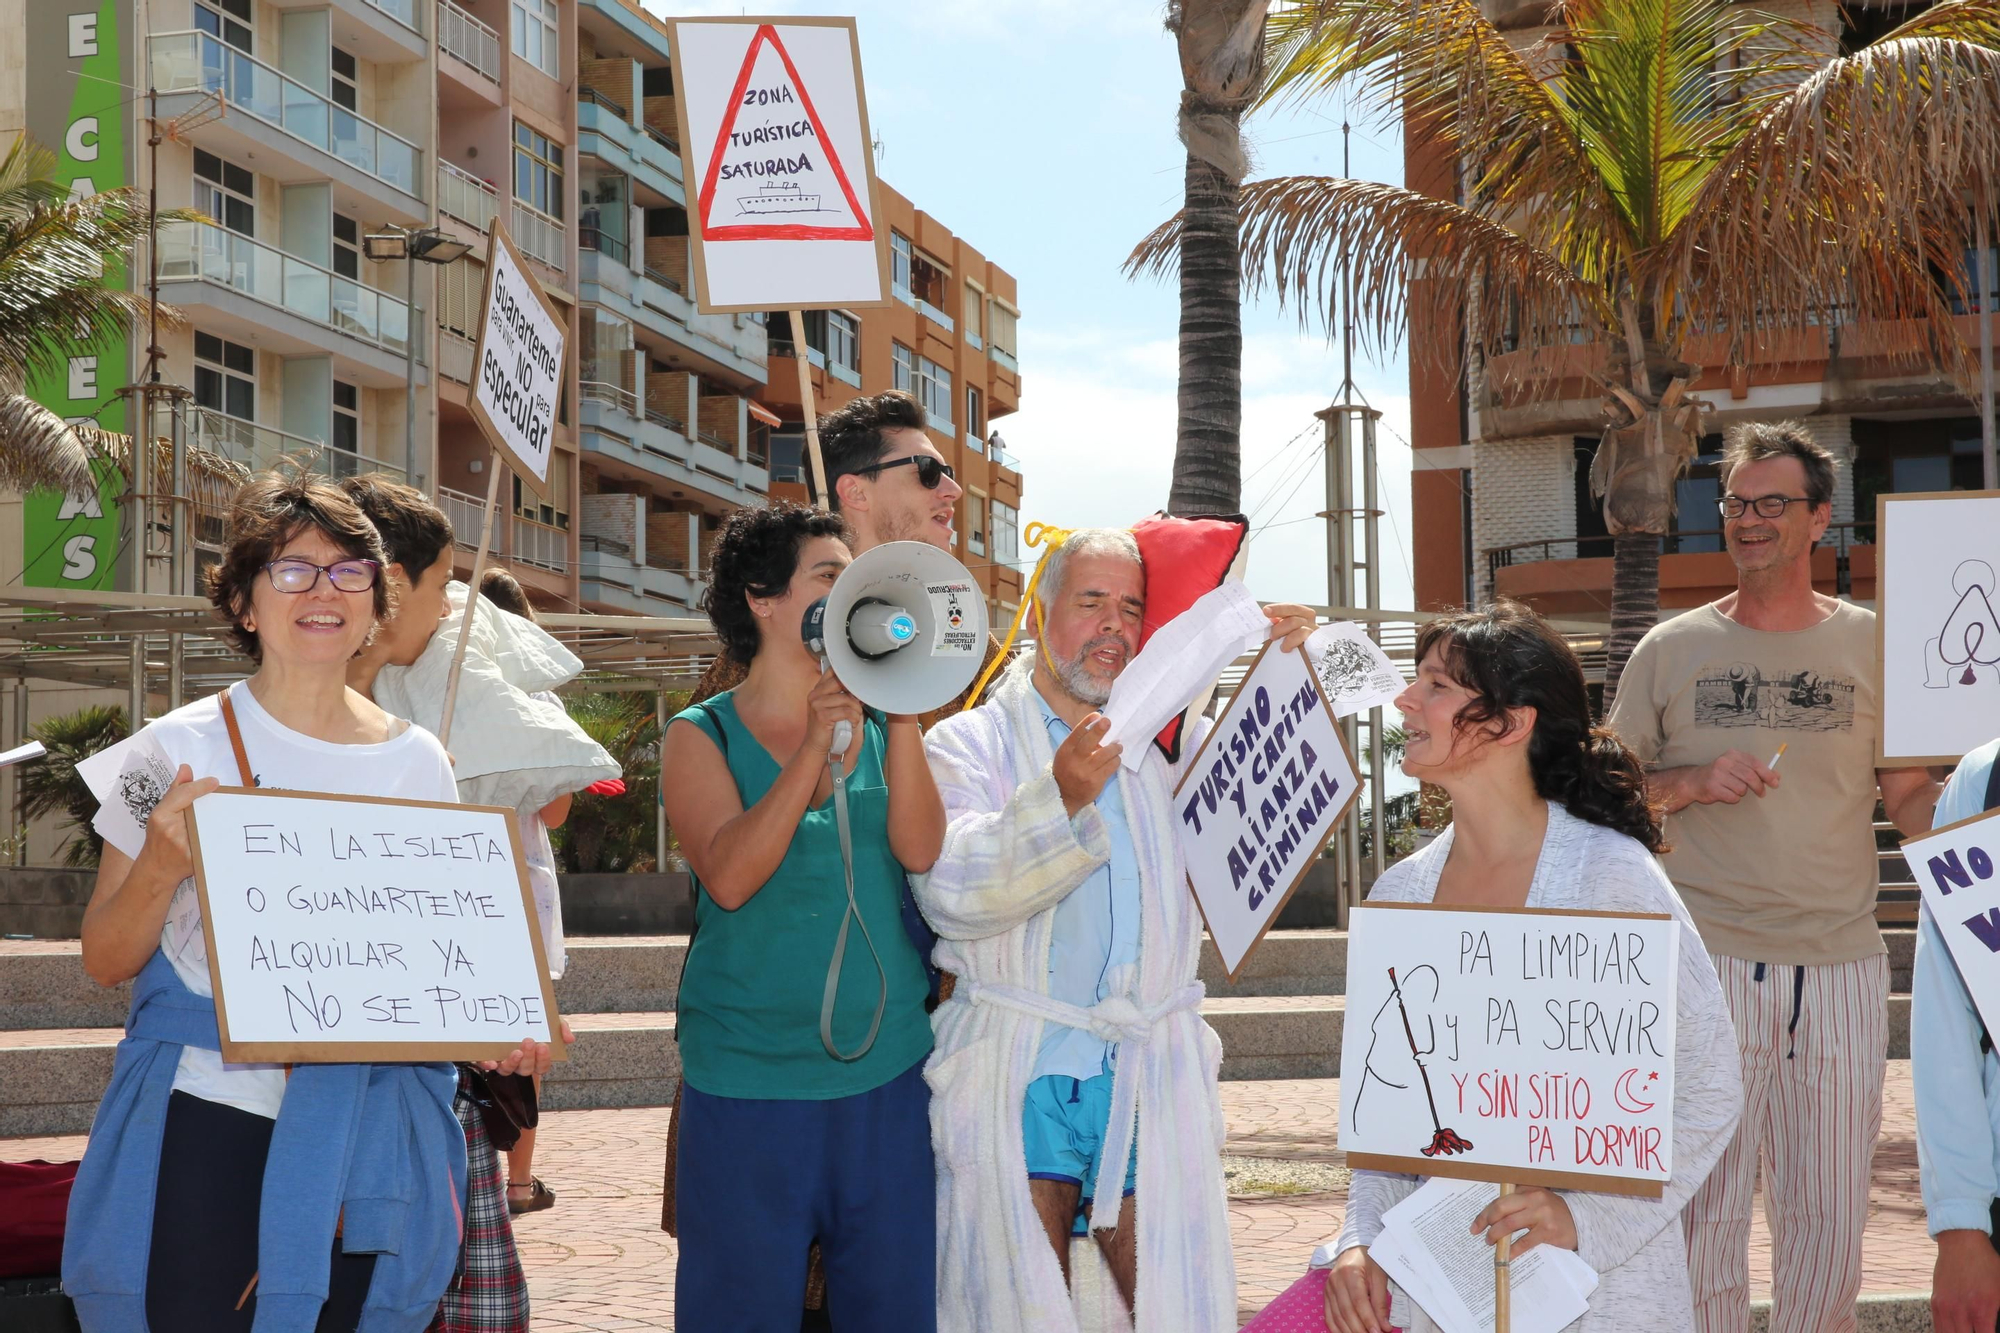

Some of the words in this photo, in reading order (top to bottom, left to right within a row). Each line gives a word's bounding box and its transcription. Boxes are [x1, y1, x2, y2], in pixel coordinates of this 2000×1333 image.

[743, 84, 794, 106] ZONA
[730, 119, 814, 148] TURÍSTICA
[720, 152, 814, 180] SATURADA
[495, 268, 556, 382] Guanarteme
[491, 305, 502, 333] para
[502, 324, 515, 356] vivir,
[515, 350, 533, 393] NO
[535, 392, 550, 418] para
[484, 348, 548, 454] especular
[927, 585, 950, 594] CRUDO
[243, 824, 302, 856] EN
[1927, 846, 1994, 896] NO
[246, 887, 266, 912] O
[286, 885, 505, 918] GUANARTEME
[432, 938, 475, 977] YA
[1460, 930, 1493, 976] PA
[283, 980, 342, 1033] NO
[362, 995, 420, 1024] SE
[424, 985, 543, 1028] PUEDE
[1486, 997, 1521, 1045] PA
[1451, 1072, 1469, 1114] Y
[1528, 1124, 1555, 1163] PA
